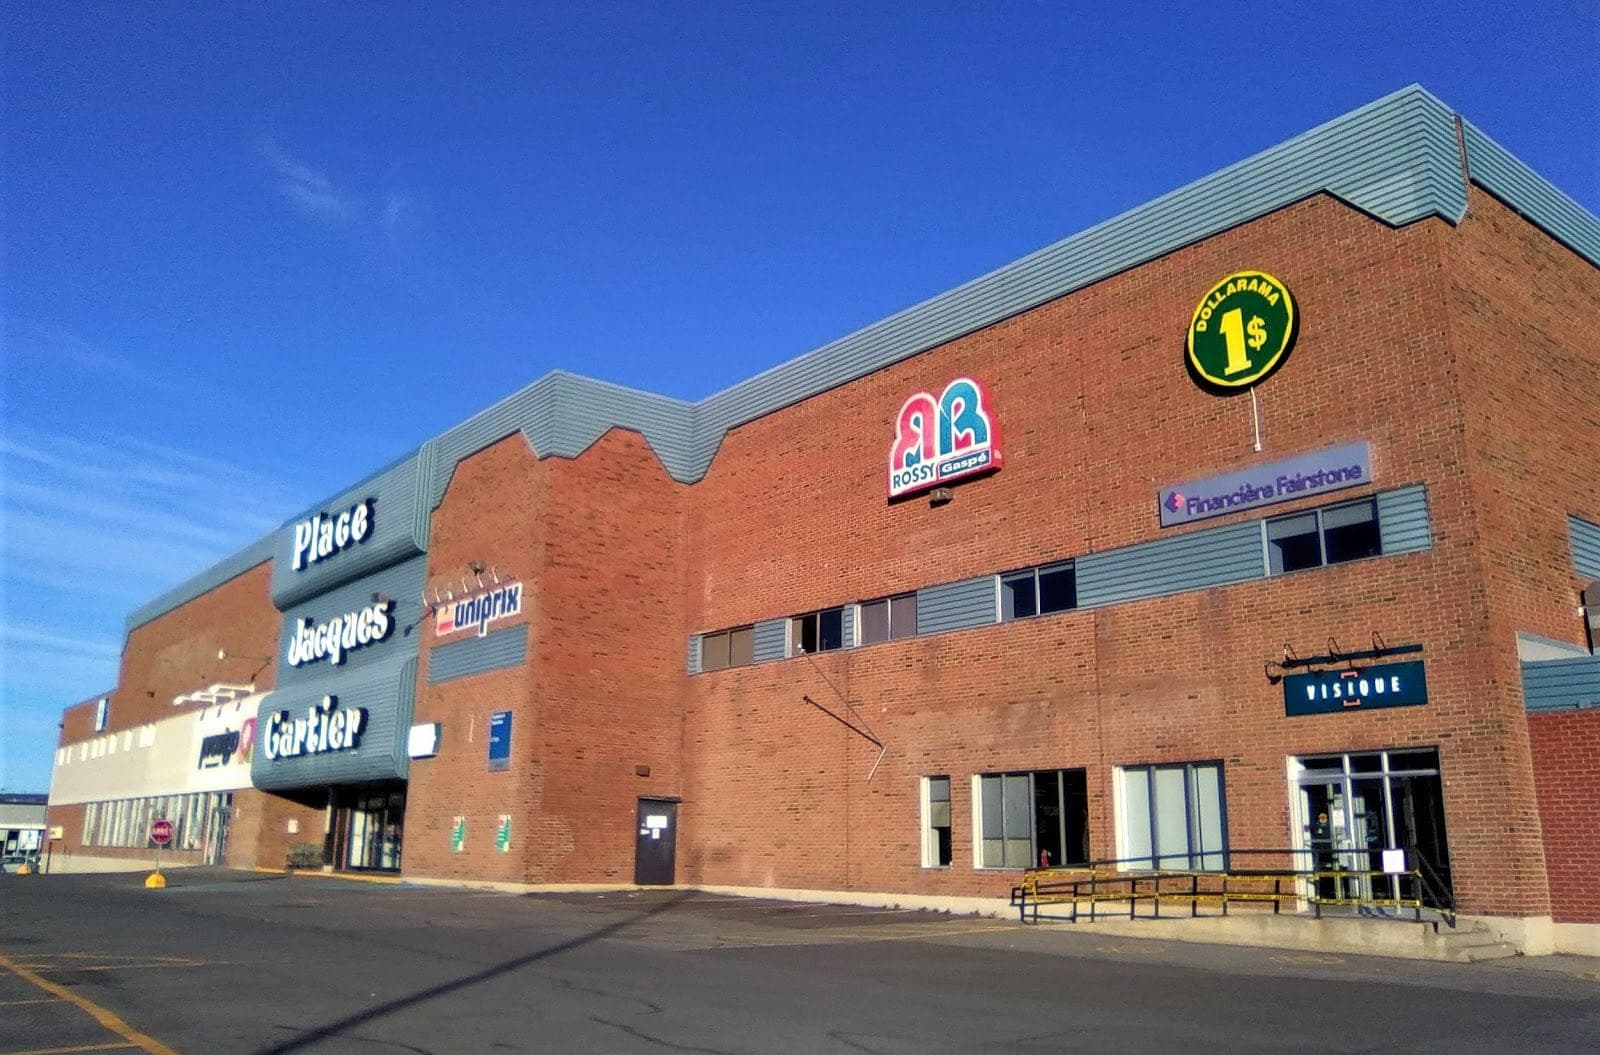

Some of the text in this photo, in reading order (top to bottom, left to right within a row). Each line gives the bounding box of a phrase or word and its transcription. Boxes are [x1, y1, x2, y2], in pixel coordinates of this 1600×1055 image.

[1195, 278, 1280, 332] DOLLARAMA
[893, 463, 936, 489] ROSSY
[941, 452, 988, 474] Gaspé
[1186, 463, 1363, 516] Financière Fairstone
[291, 503, 369, 571] Place
[287, 601, 390, 667] Jacques
[453, 585, 520, 636] uniprix
[1306, 675, 1401, 701] VISIQUE
[263, 695, 362, 760] Cartier
